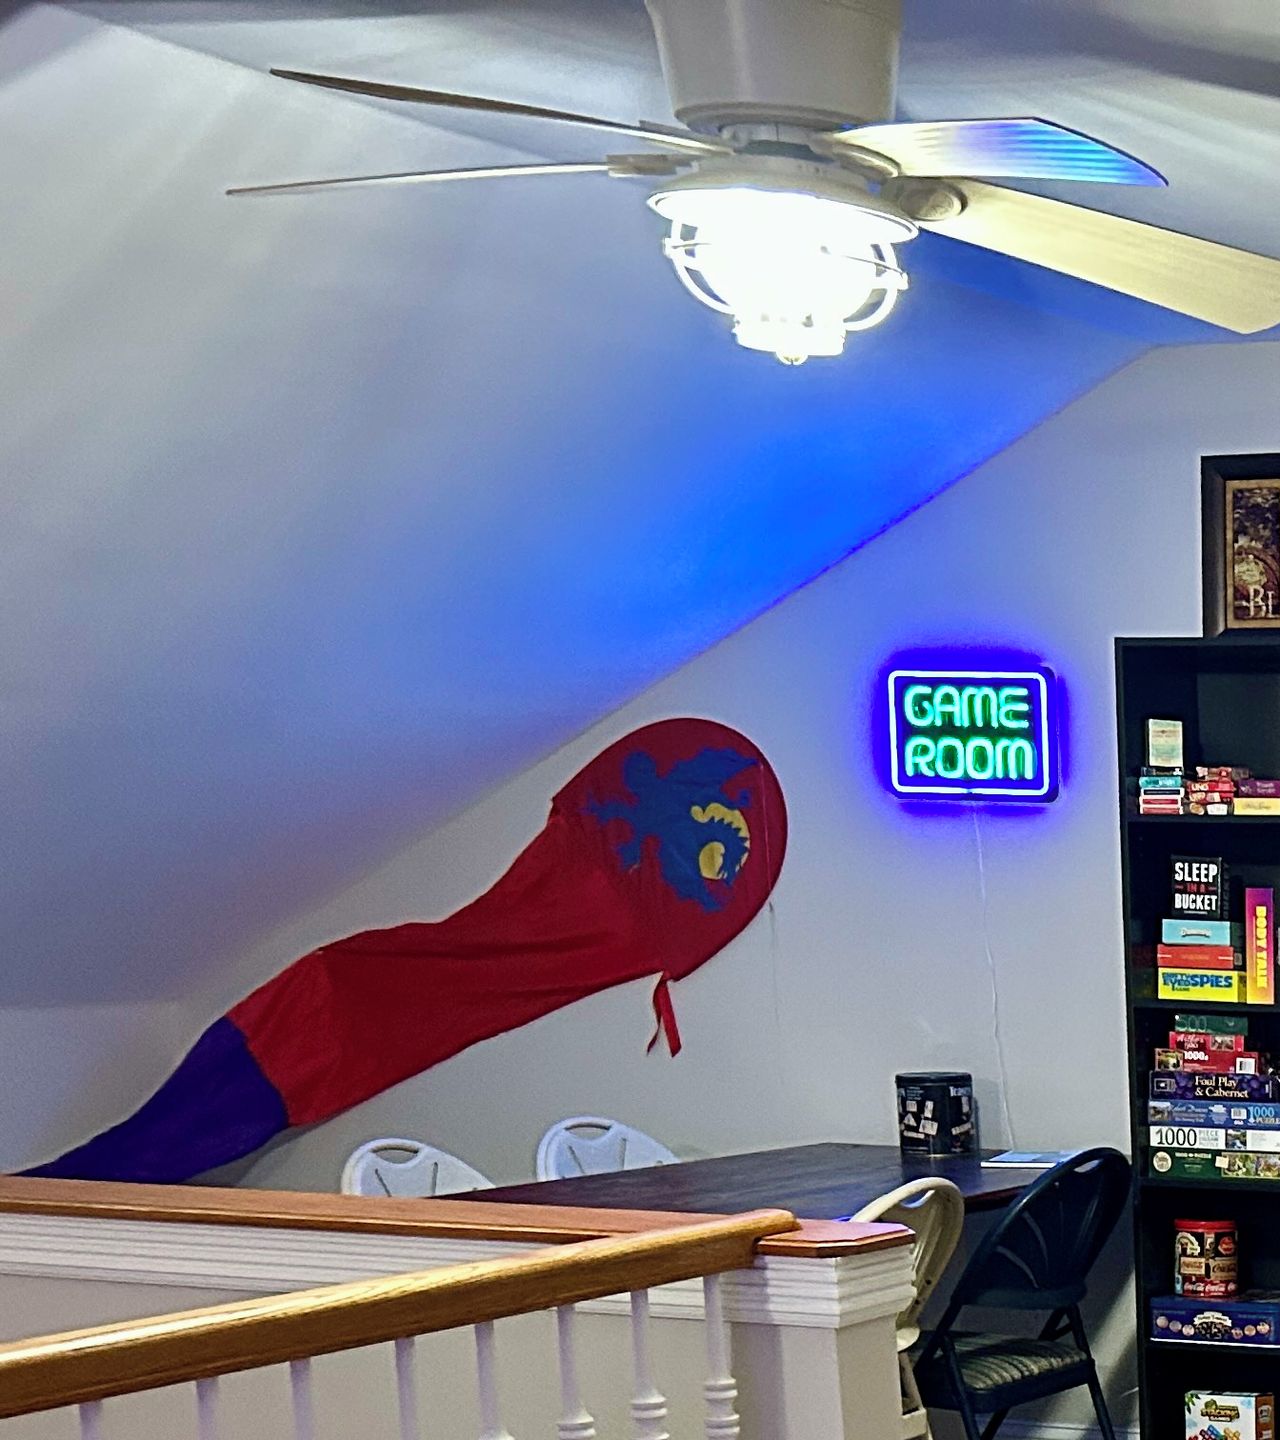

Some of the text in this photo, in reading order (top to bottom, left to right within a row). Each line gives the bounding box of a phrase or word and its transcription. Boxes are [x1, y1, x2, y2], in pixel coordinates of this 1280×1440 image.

[904, 684, 1030, 728] GAME
[904, 735, 1036, 780] ROOM
[1174, 861, 1218, 883] SLEEP
[1174, 893, 1218, 911] BUCKET
[1256, 905, 1268, 948] BODY
[1190, 974, 1233, 988] SPIES
[1195, 1076, 1239, 1089] Foul Play
[1195, 1087, 1249, 1098] & Cabernet
[1247, 1106, 1275, 1121] 1000
[1155, 1127, 1198, 1147] 1000
